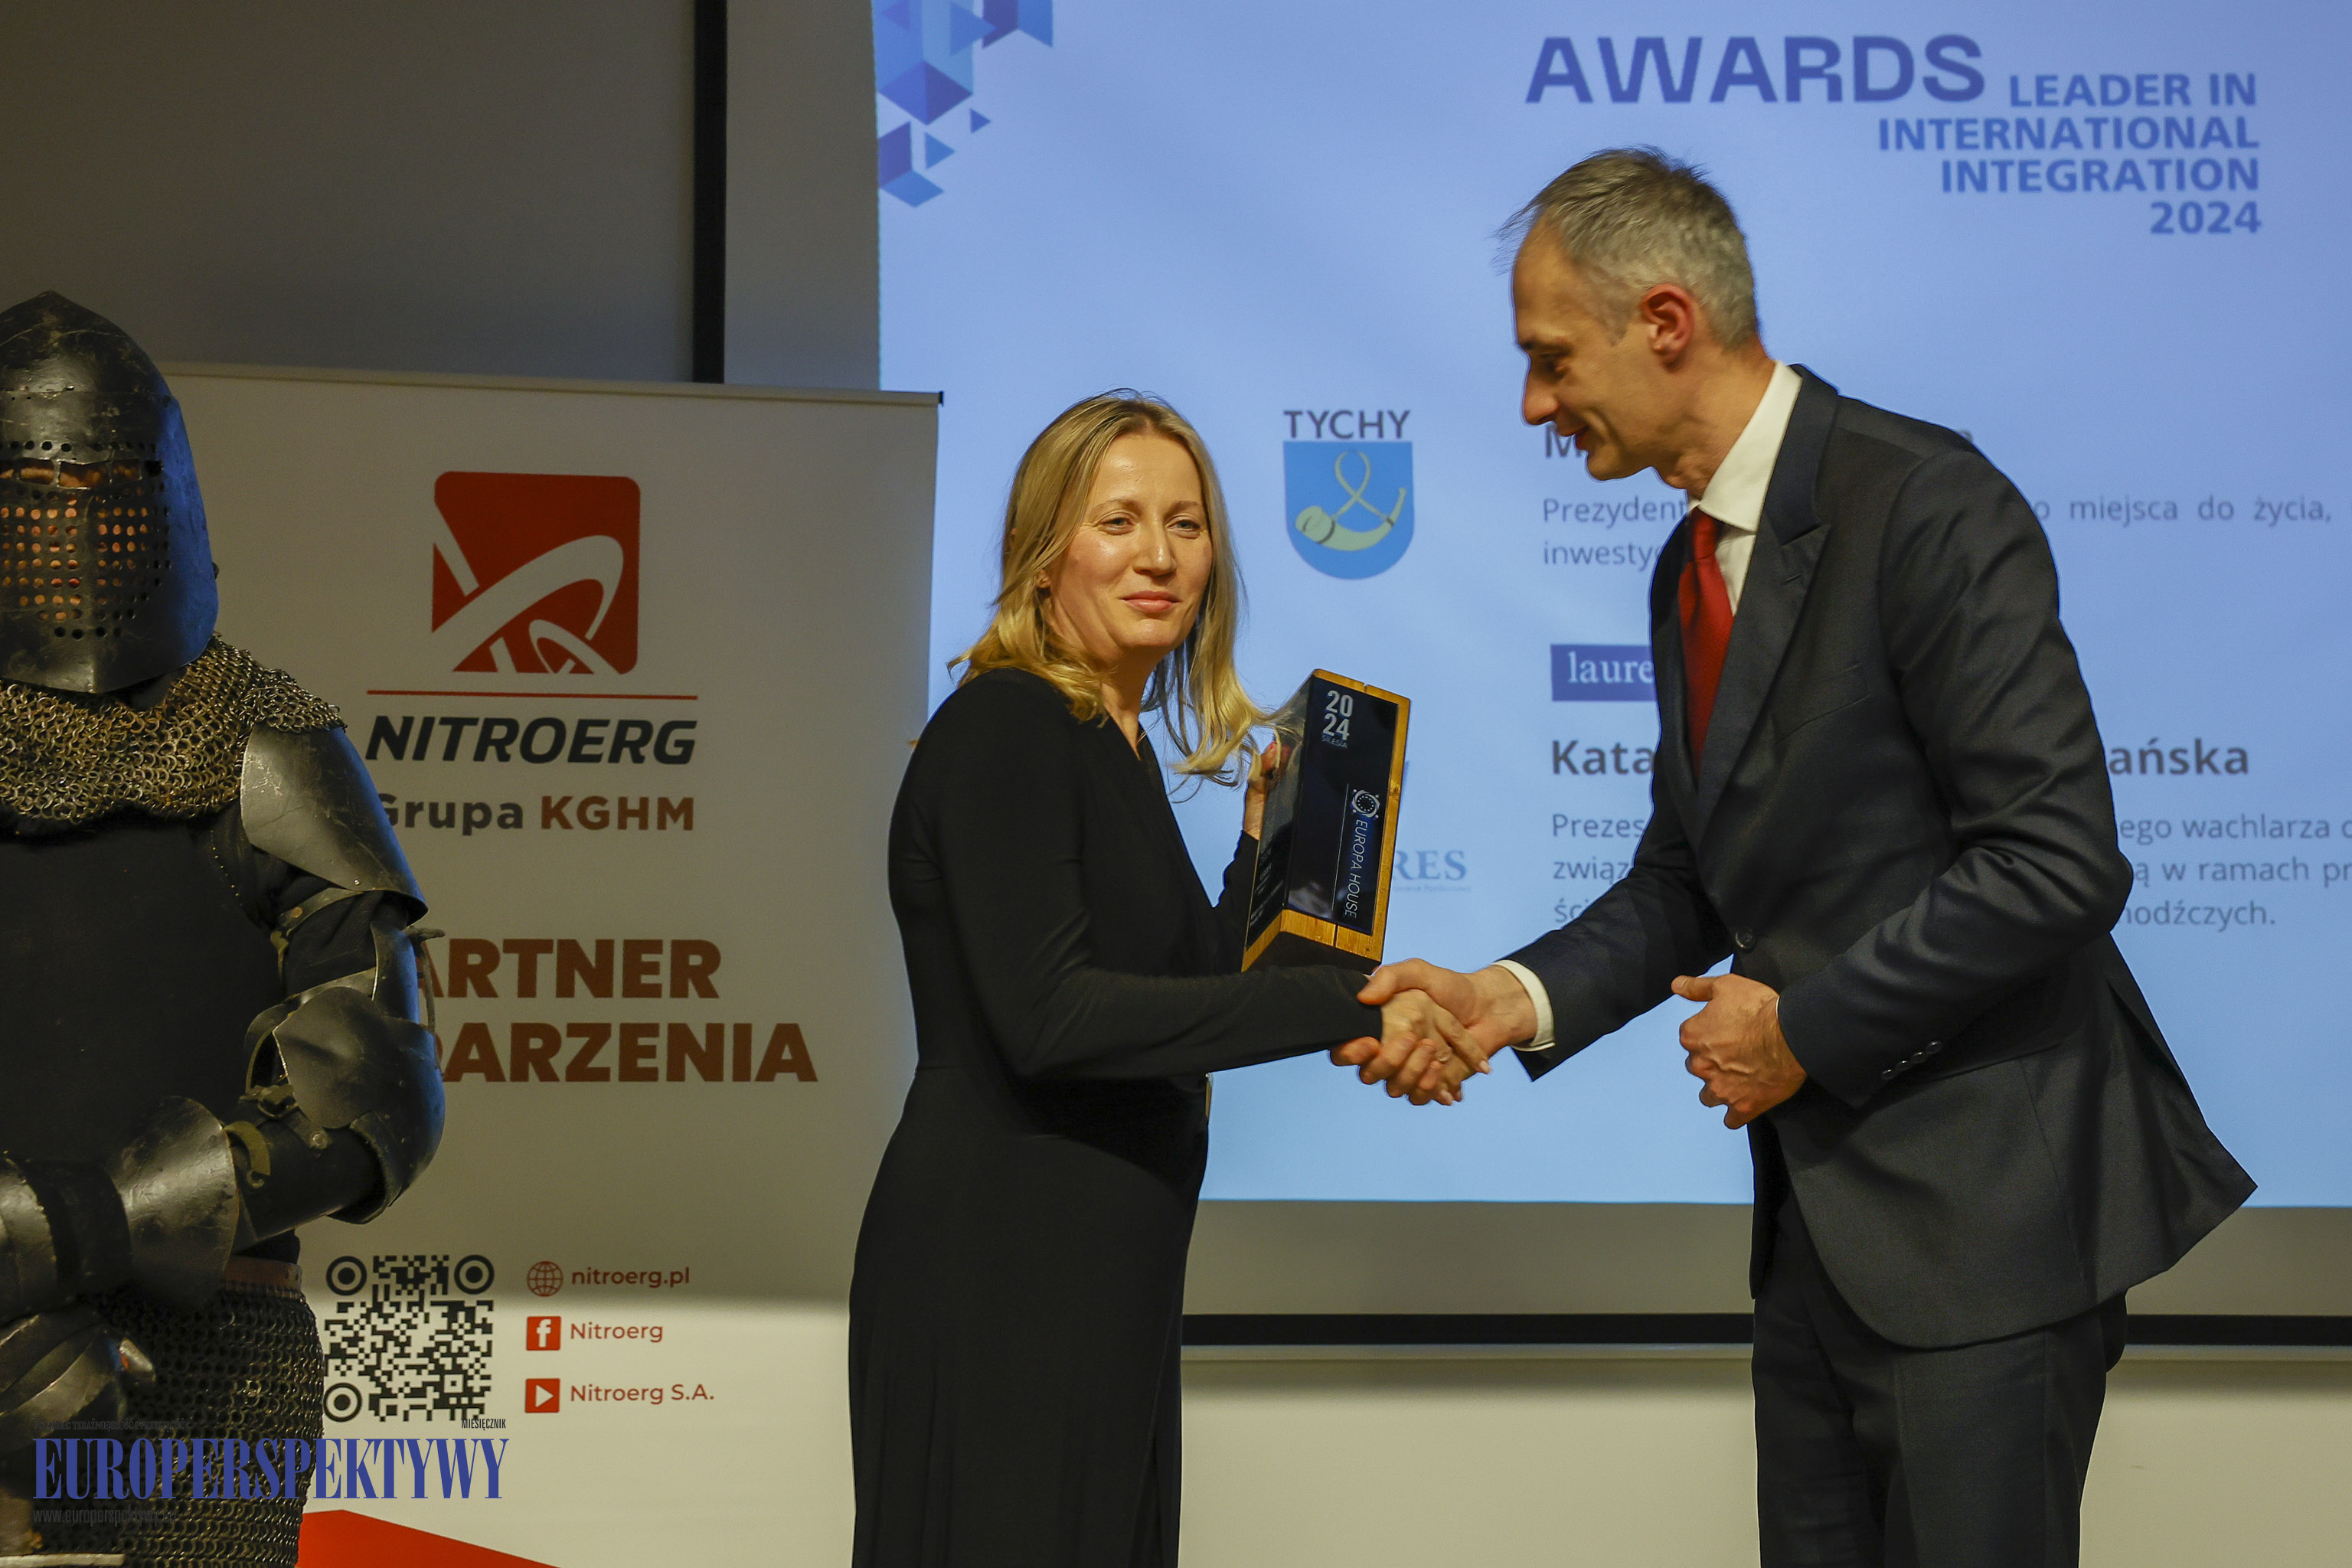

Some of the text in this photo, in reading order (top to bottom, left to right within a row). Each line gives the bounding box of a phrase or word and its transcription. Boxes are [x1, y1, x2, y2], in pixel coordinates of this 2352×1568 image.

[1525, 34, 1985, 104] AWARDS
[2009, 72, 2257, 109] LEADER IN
[1879, 116, 2260, 151] INTERNATIONAL
[1942, 157, 2259, 193] INTEGRATION
[2150, 200, 2262, 235] 2024
[1283, 410, 1411, 440] TYCHY
[2069, 495, 2178, 528] miejsca
[2197, 495, 2236, 521] do
[2252, 495, 2332, 527] życia,
[1543, 541, 1660, 573] inwesty
[1568, 651, 1655, 684] laure
[1325, 690, 1354, 718] 20
[365, 714, 697, 766] NITROERG
[1322, 713, 1350, 740] 24
[1552, 737, 2249, 776] Kata ańska
[541, 795, 694, 831] KGHM
[2118, 818, 2173, 846] ego
[2183, 812, 2331, 839] wachlarza
[1344, 818, 1368, 919] EUROPA HOUSE
[1395, 850, 1467, 880] RES
[1553, 856, 1631, 884] związ
[2161, 861, 2187, 882] w
[2197, 855, 2310, 882] ramach
[2322, 861, 2352, 888] pr
[2124, 900, 2276, 934] odźczych.
[433, 1022, 818, 1083] ARZENIA
[570, 1266, 691, 1289] nitroerg.pl
[570, 1321, 664, 1344] Nitroerg
[570, 1383, 715, 1406] Nitroerg S.A.
